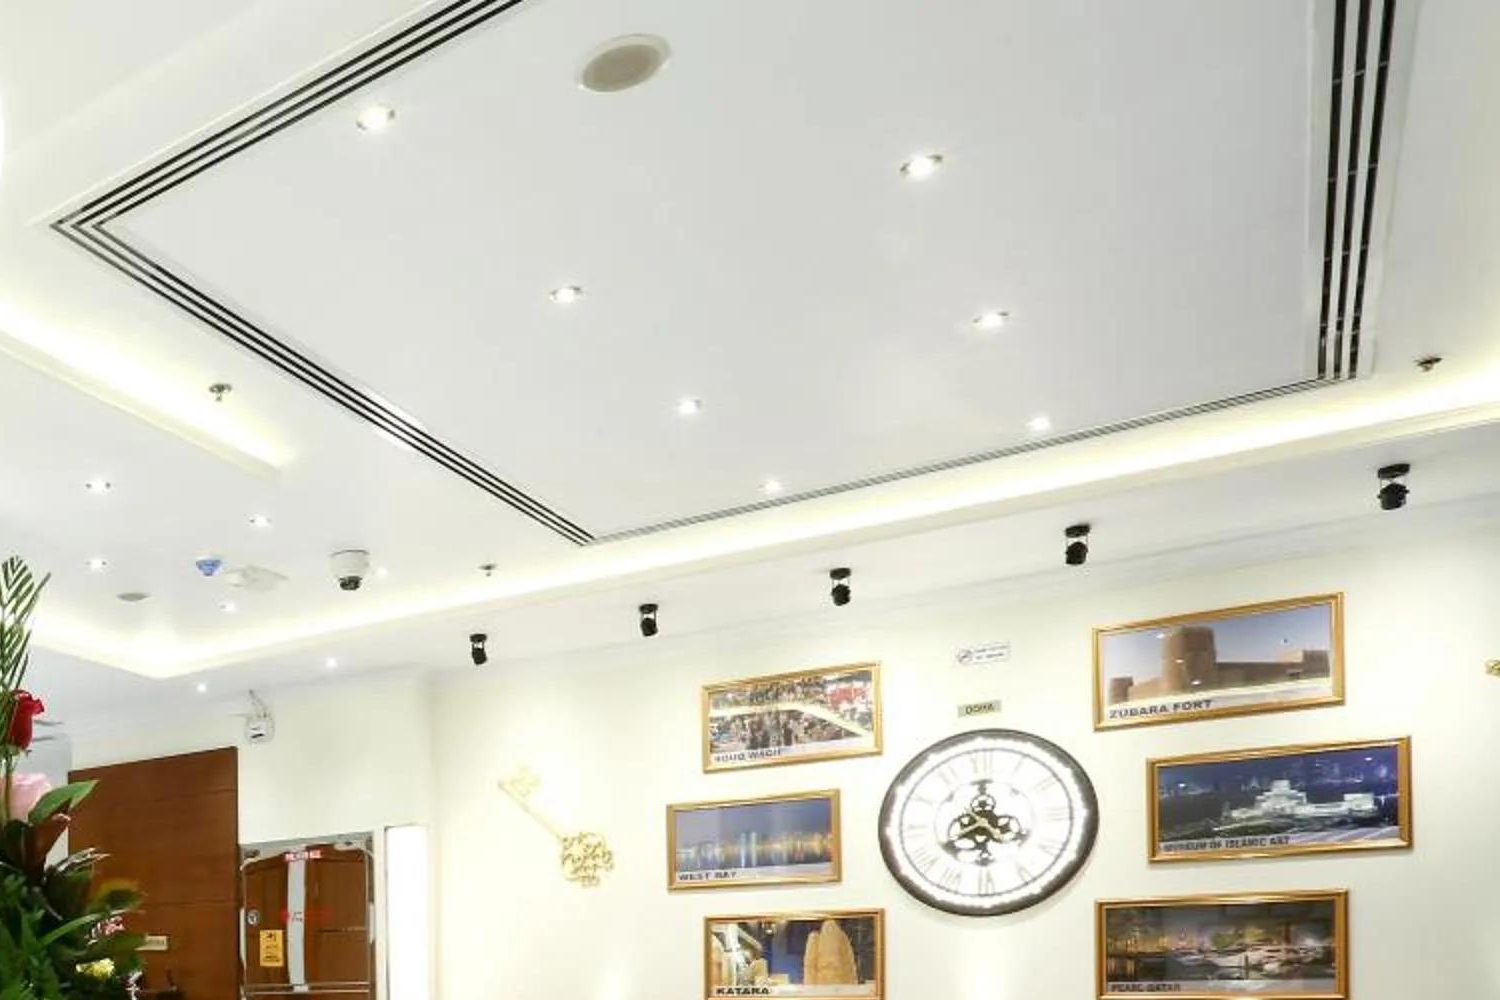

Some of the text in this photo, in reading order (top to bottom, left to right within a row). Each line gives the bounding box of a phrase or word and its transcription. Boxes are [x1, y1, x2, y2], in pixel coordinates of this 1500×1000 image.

[1108, 700, 1212, 719] ZUBARA FORT
[679, 871, 711, 881] WEST
[715, 986, 769, 996] KATARA
